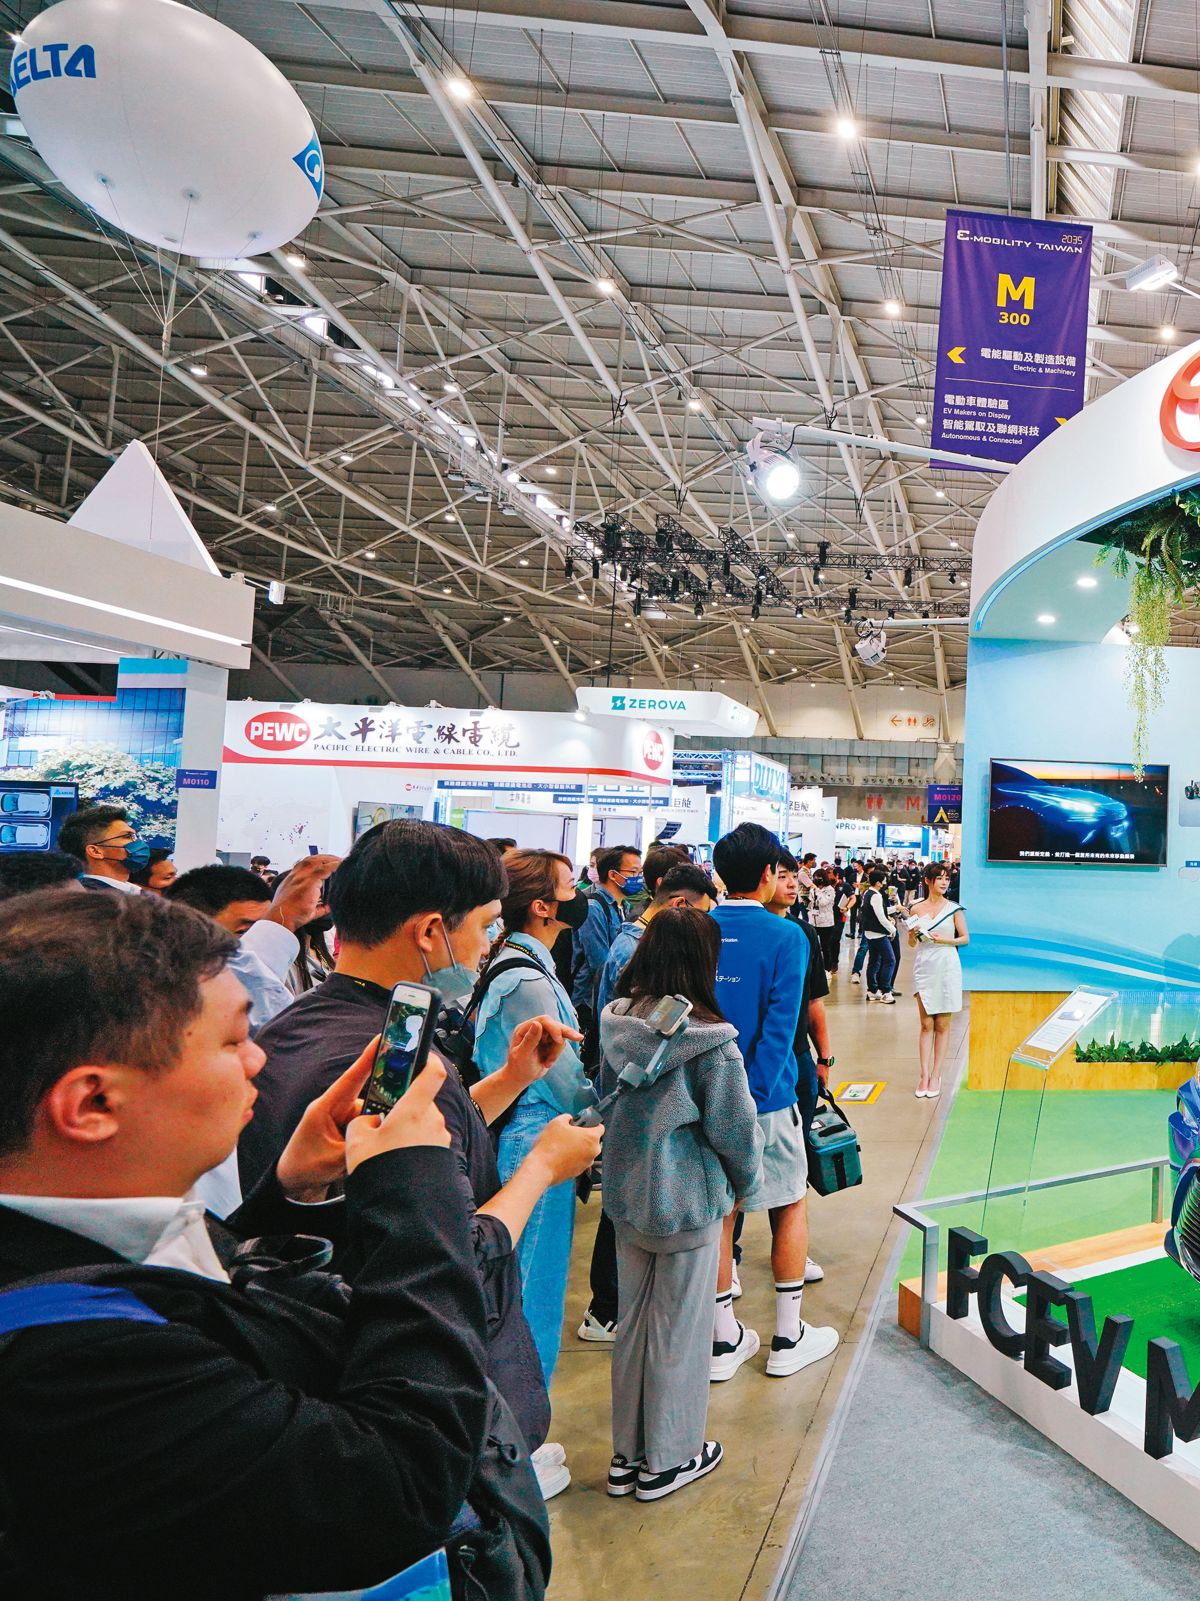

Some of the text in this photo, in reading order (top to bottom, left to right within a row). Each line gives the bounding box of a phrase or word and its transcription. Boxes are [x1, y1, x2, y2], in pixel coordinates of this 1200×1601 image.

[10, 43, 97, 98] ELTA
[1035, 242, 1083, 254] TAIWAN
[997, 273, 1035, 310] M
[998, 312, 1030, 326] 300
[981, 348, 1076, 367] 電能驅動及製造設備
[1013, 364, 1037, 373] Electric
[1044, 367, 1076, 377] Machinery
[944, 394, 1009, 410] 電動車體驗區
[953, 408, 977, 417] Makers
[988, 411, 1011, 420] Display
[943, 419, 1040, 437] 智能駕馭及聯網科技
[941, 432, 981, 442] Autonomous
[988, 436, 1023, 445] Connected
[628, 698, 687, 711] ZEROVA
[249, 721, 309, 743] PEWC
[312, 715, 521, 749] 太平洋電線電纜
[313, 743, 350, 752] PACIFIC
[355, 744, 400, 753] ELECTRIC
[405, 746, 431, 754] WIRE
[497, 749, 518, 758] LTD.
[182, 778, 210, 786] M0110
[947, 1226, 1134, 1416] FCEV
